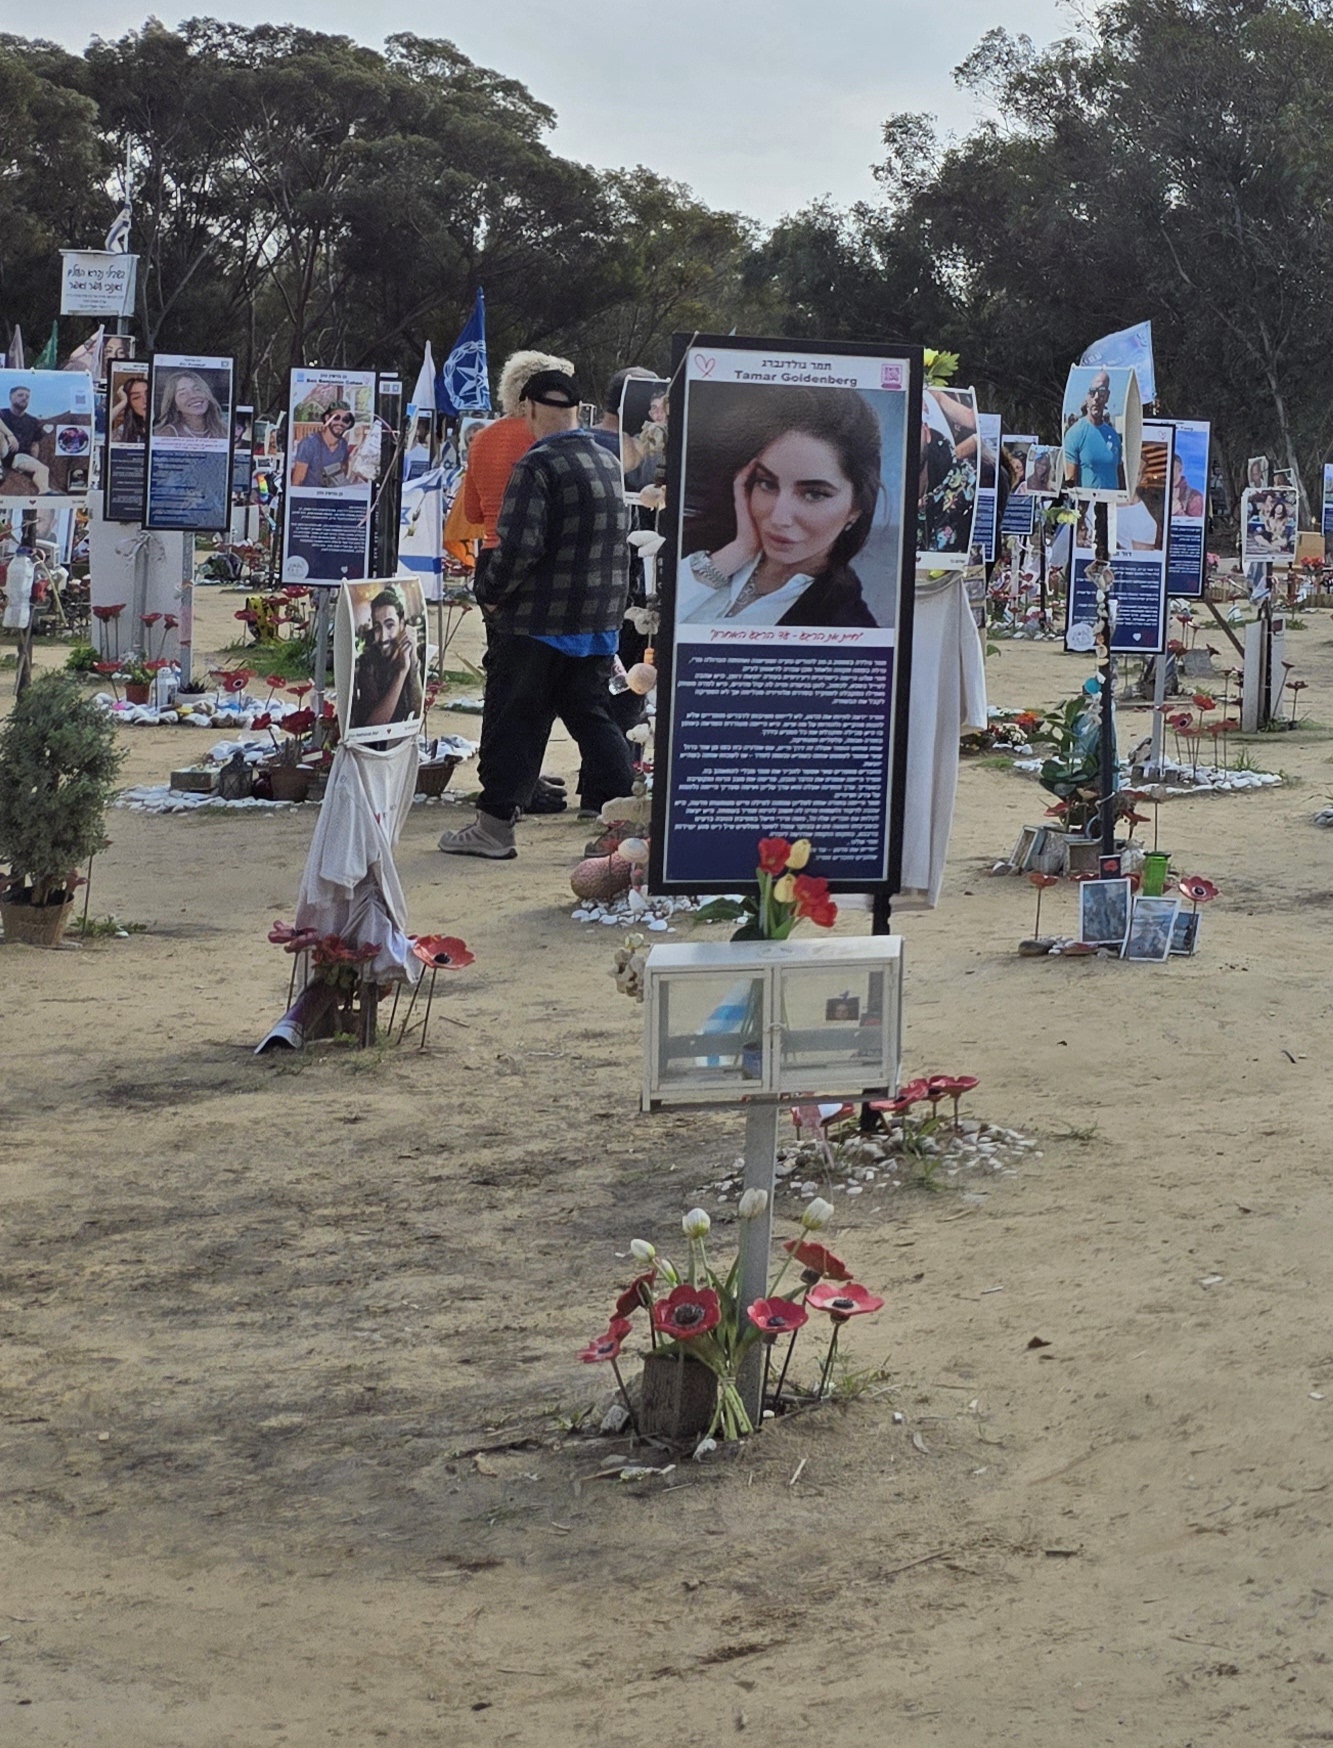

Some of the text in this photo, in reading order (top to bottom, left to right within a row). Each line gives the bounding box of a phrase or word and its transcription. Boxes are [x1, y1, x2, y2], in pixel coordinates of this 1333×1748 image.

[811, 362, 832, 371] תמר
[734, 370, 858, 388] Tamar Goldenberg
